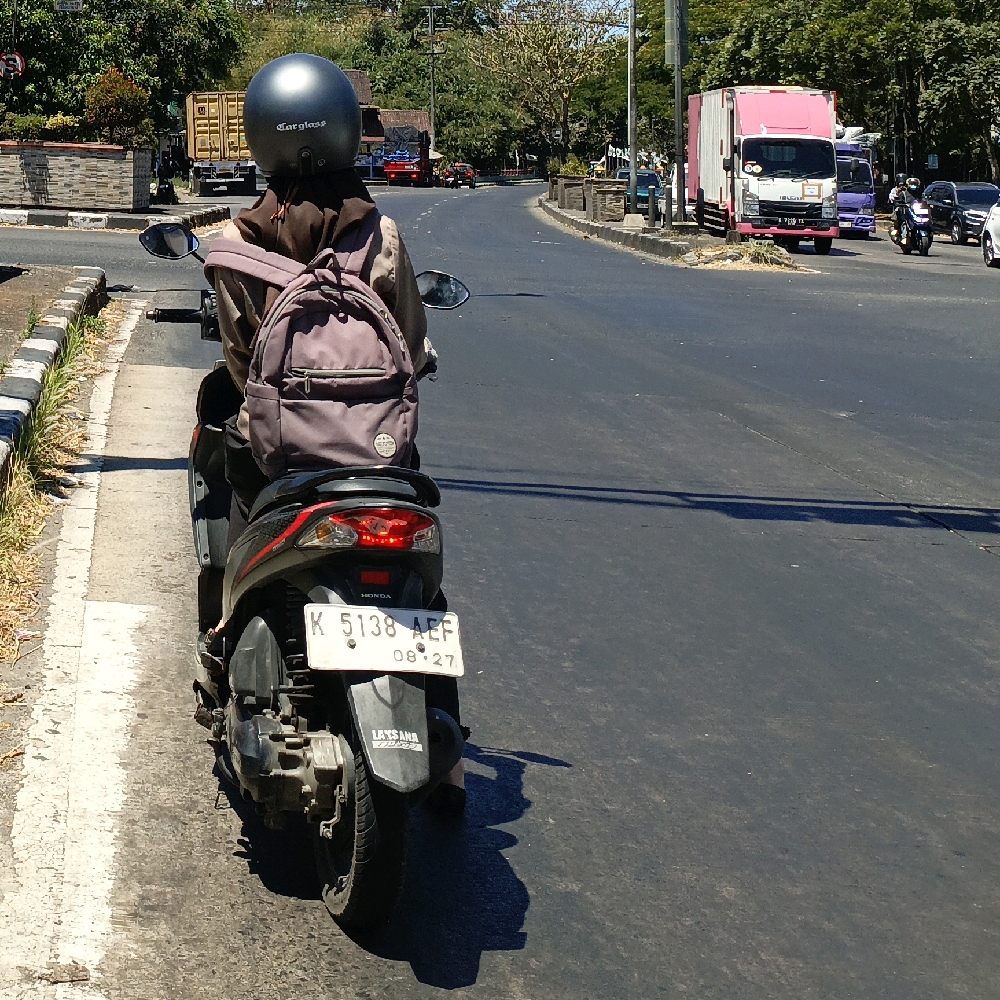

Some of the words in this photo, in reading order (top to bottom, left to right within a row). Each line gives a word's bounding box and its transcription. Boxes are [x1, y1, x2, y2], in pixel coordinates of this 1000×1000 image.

[310, 612, 325, 636] K
[340, 613, 397, 638] 5138
[412, 616, 454, 642] AEF
